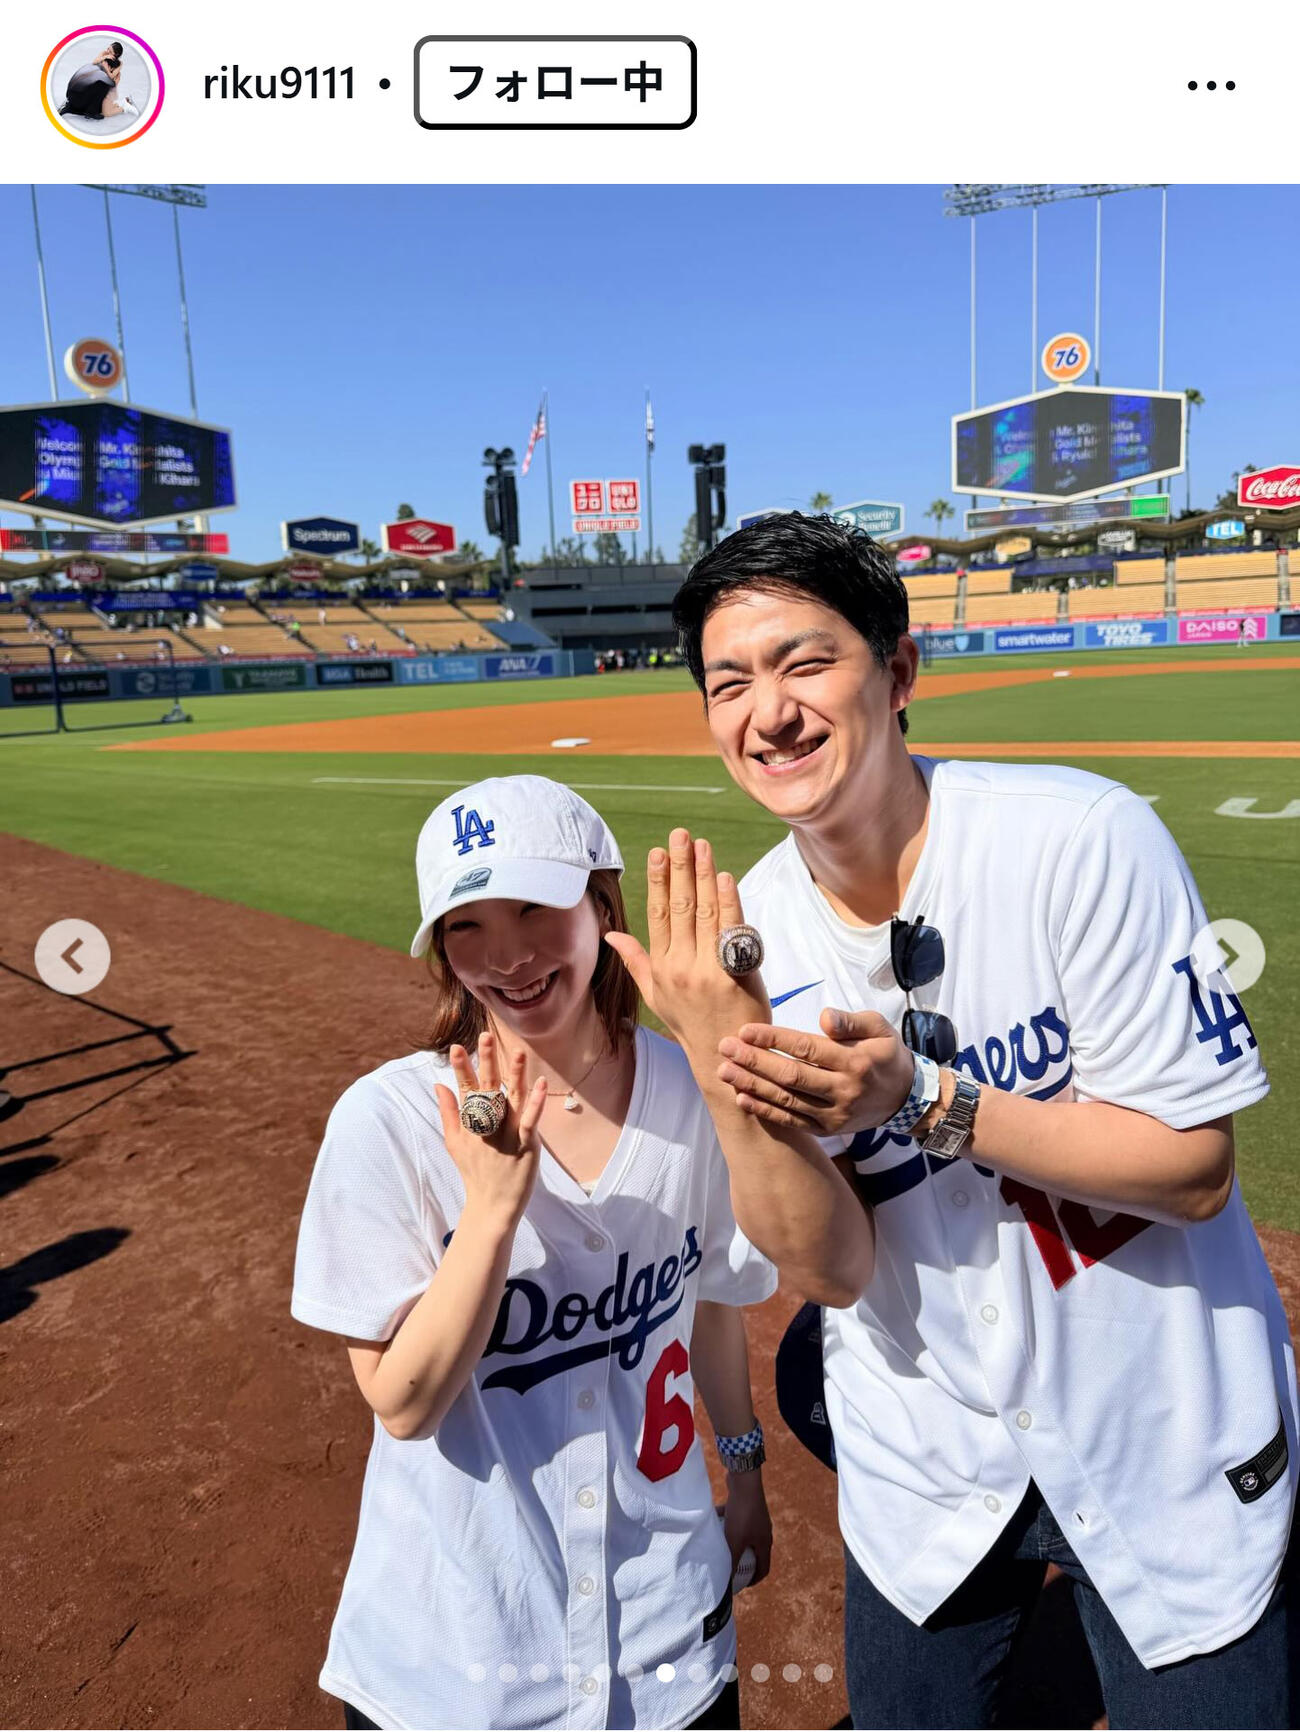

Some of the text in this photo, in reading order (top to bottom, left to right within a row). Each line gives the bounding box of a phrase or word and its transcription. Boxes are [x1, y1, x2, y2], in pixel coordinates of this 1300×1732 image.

[83, 354, 113, 376] 76
[1055, 347, 1079, 367] 76
[857, 510, 896, 522] Security
[293, 527, 351, 543] Spectrum
[1212, 521, 1239, 538] TEL
[1097, 622, 1143, 636] TOYO
[1186, 621, 1238, 634] DAISO
[997, 631, 1072, 648] smartwater
[1104, 632, 1154, 646] TIRES
[403, 662, 438, 679] TEL
[499, 658, 526, 671] ANA
[451, 804, 496, 856] LA
[1172, 954, 1257, 1066] LA
[636, 1338, 694, 1483] 6
